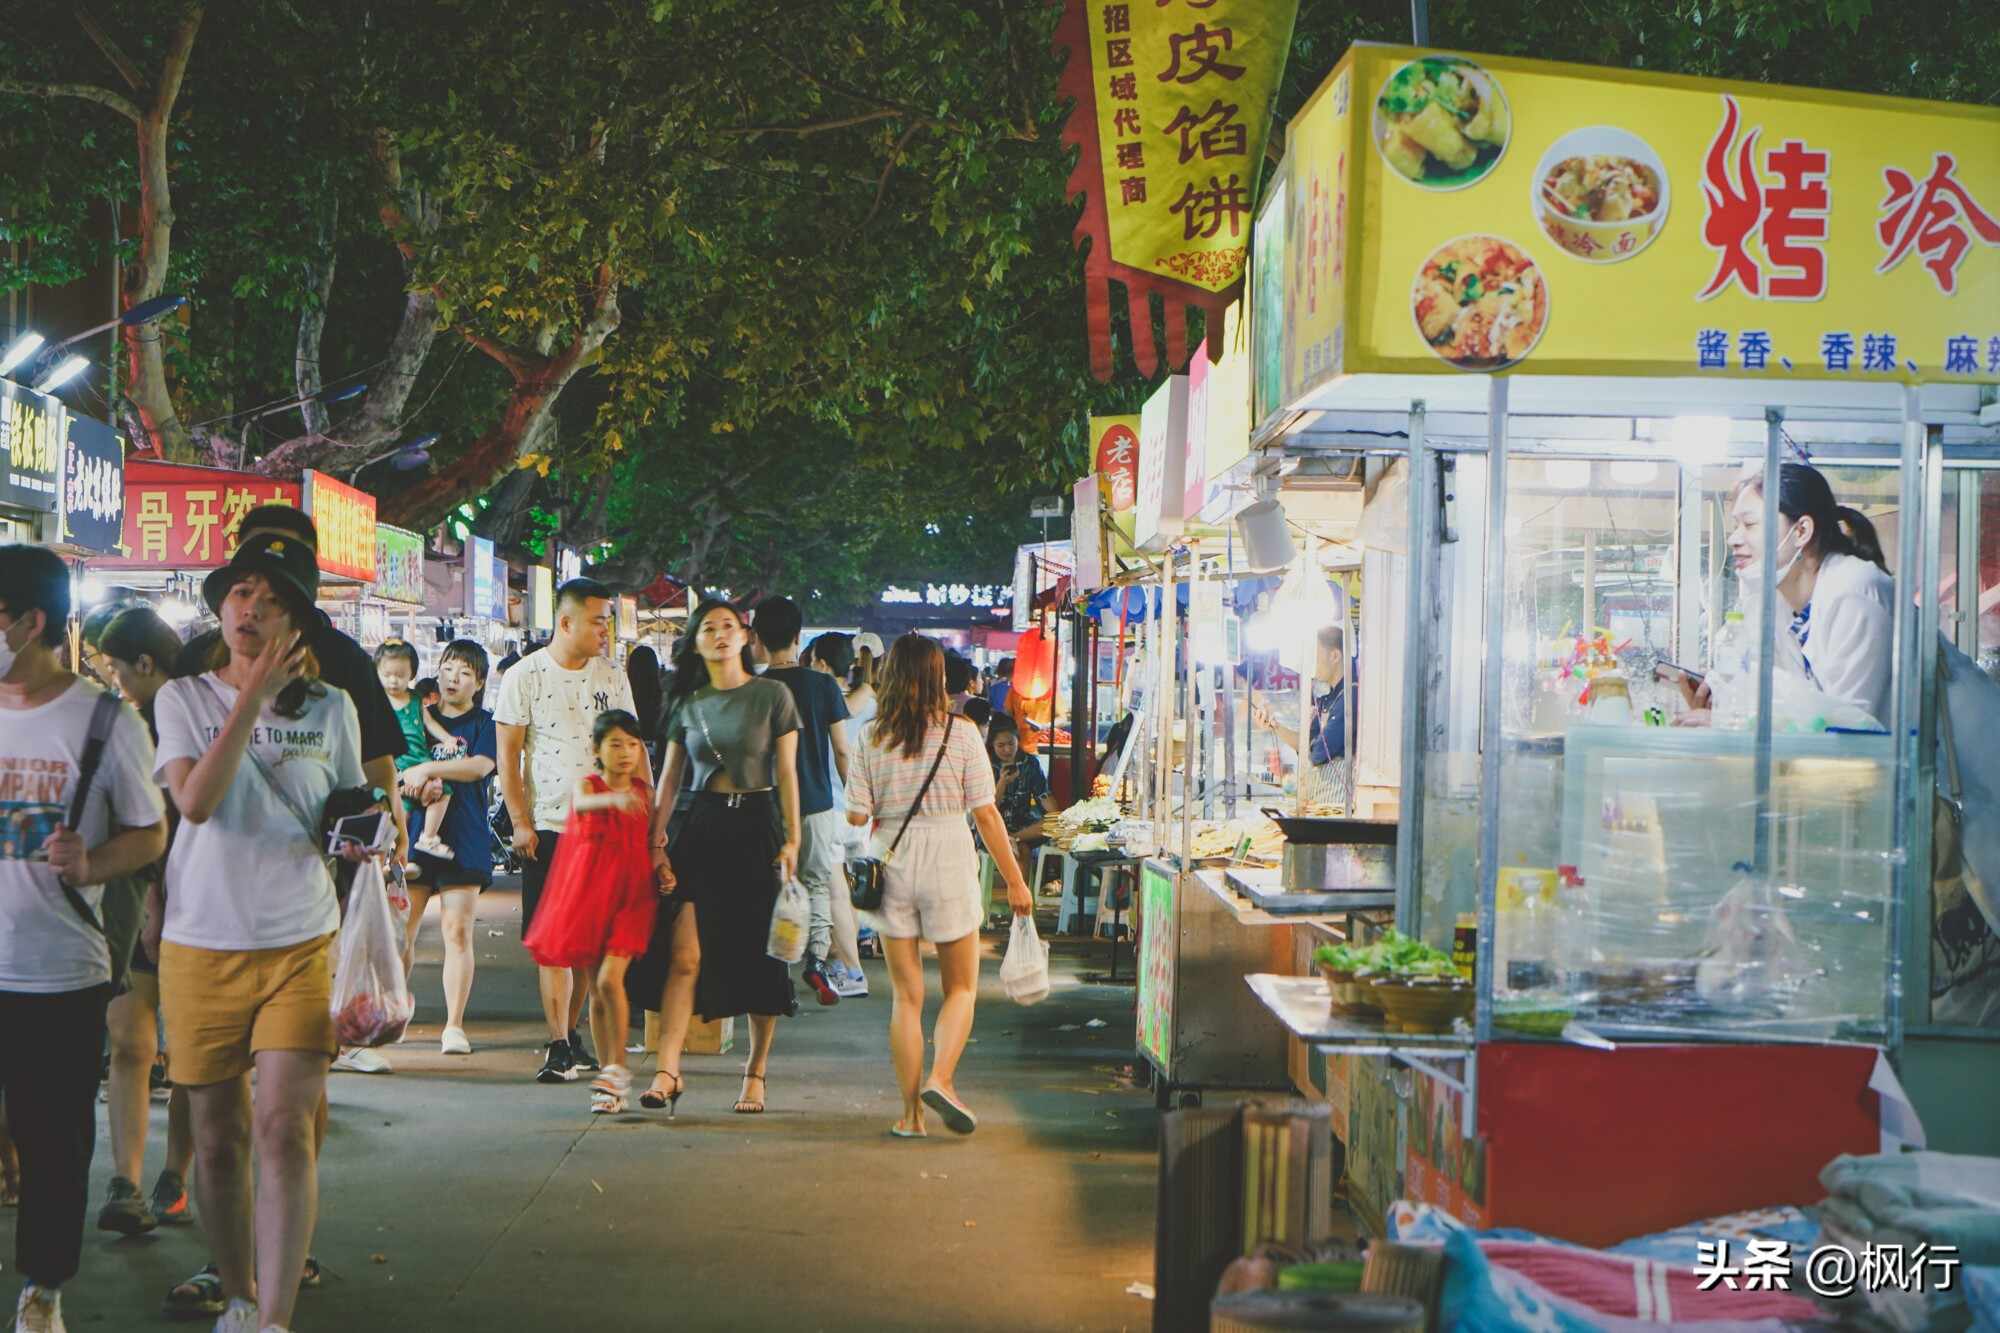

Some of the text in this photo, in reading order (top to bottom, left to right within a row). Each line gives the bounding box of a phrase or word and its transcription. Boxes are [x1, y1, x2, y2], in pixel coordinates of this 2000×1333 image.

[1103, 4, 1147, 206] 招区域代理商
[1155, 0, 1251, 241] 皮馅饼
[1106, 435, 1134, 501] 老店
[265, 727, 283, 744] TO
[286, 730, 324, 747] MARS
